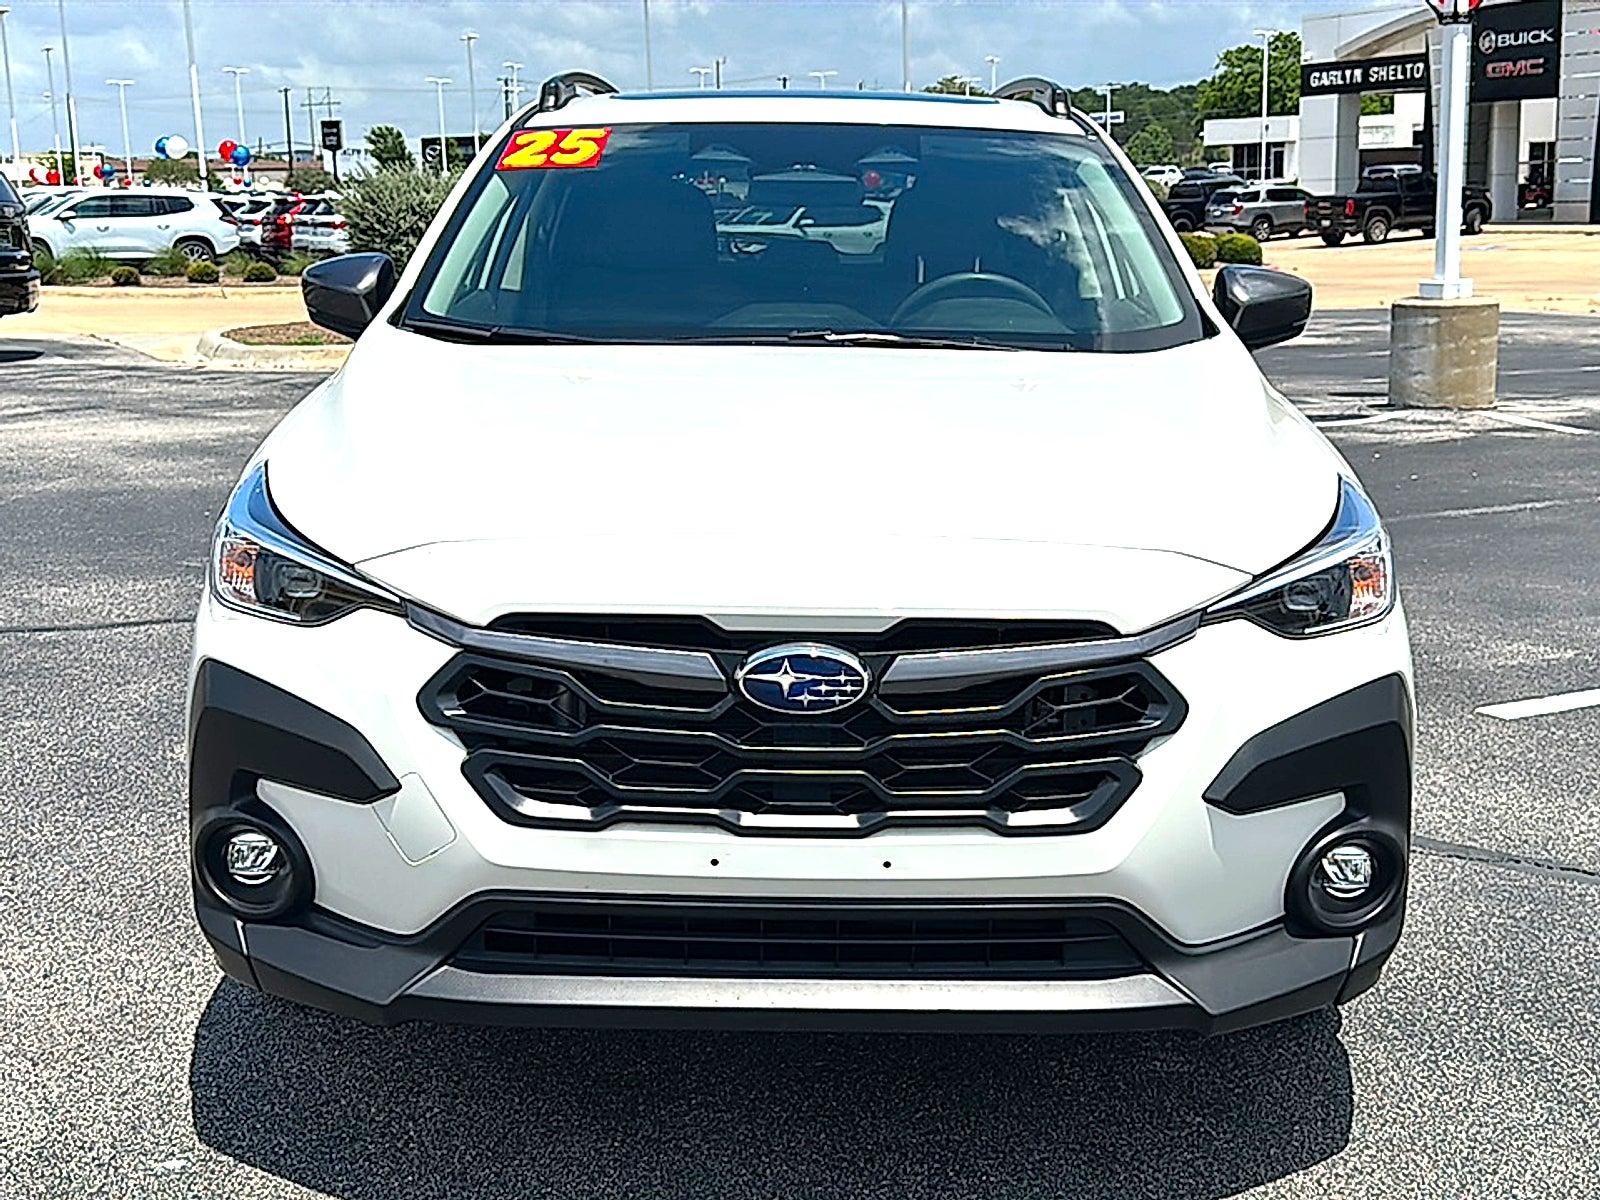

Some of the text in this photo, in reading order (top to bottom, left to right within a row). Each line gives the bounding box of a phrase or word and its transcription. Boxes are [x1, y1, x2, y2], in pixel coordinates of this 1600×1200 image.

[1497, 28, 1555, 48] BUICK
[1486, 57, 1544, 78] GMC
[1309, 68, 1363, 88] GARLYN
[502, 128, 607, 168] 25
